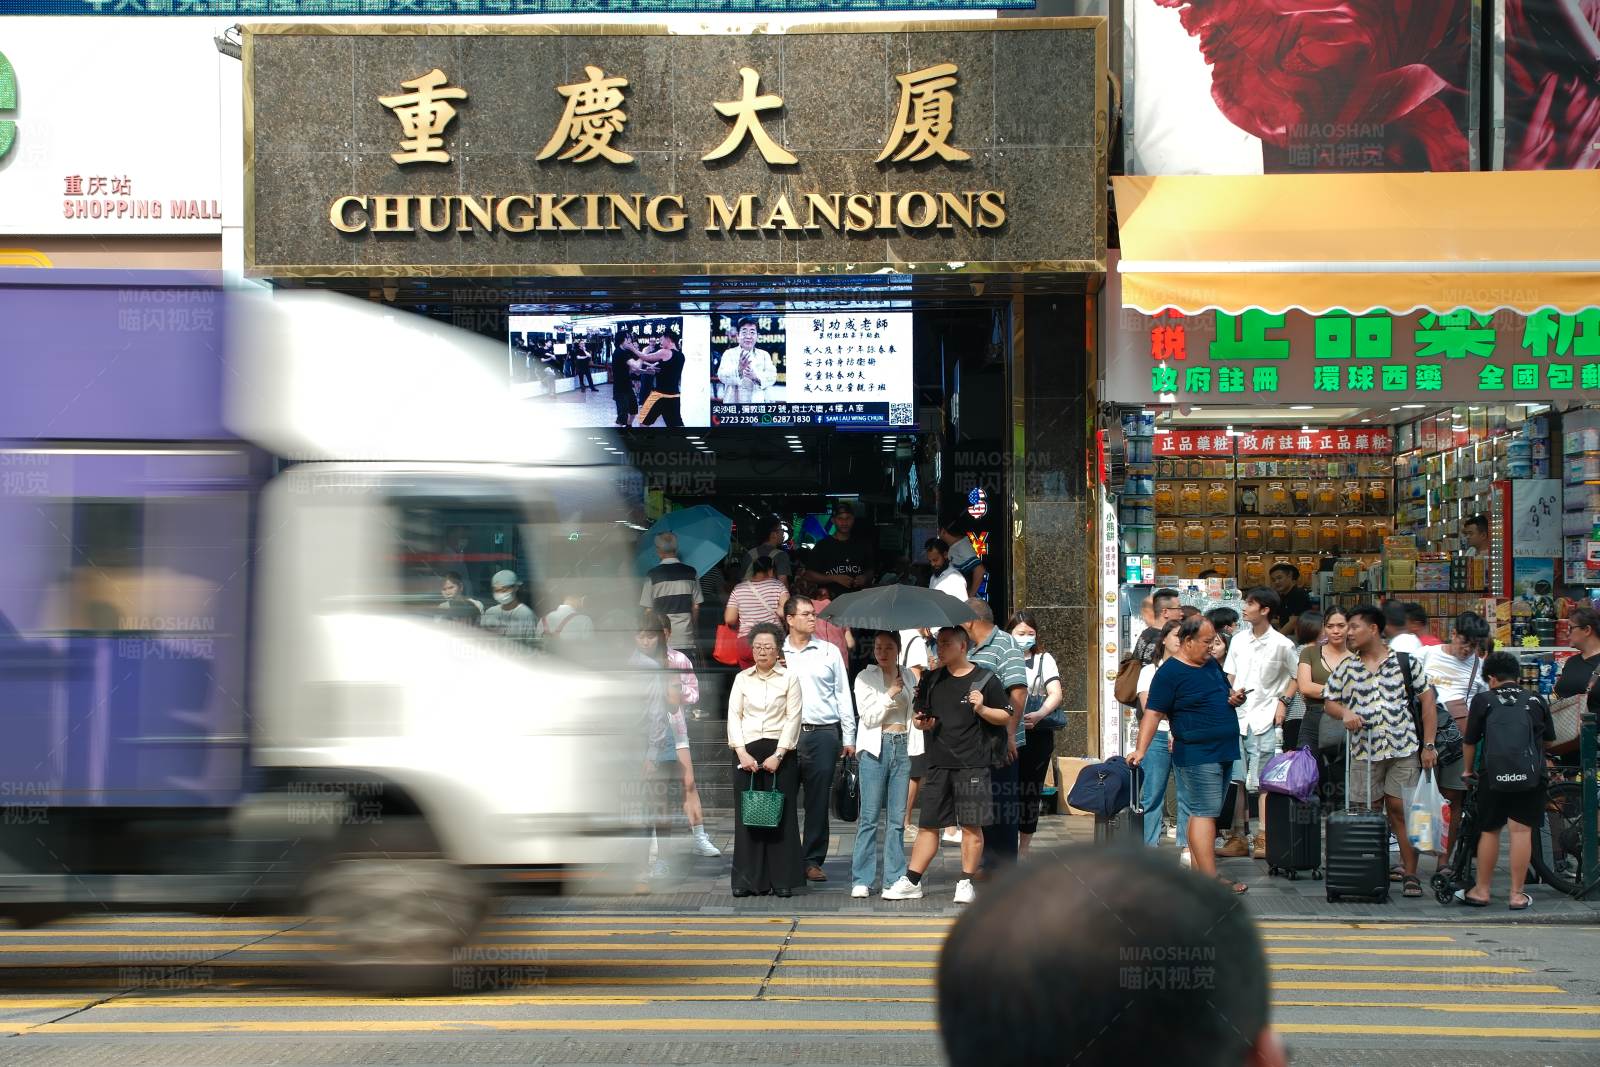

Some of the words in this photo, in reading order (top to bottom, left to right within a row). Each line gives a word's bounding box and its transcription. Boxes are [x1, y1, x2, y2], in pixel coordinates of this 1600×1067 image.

[64, 175, 132, 196] 重庆站
[63, 199, 162, 219] SHOPPING
[170, 199, 222, 219] MALL
[330, 193, 688, 234] CHUNGKING
[705, 191, 1007, 232] MANSIONS
[1151, 366, 1279, 393] 政府註冊
[1313, 364, 1443, 392] 環球西藥
[720, 416, 739, 424] 2723
[740, 416, 759, 424] 2306
[772, 415, 790, 423] 6287
[793, 415, 811, 423] 1830
[1162, 436, 1228, 451] 正品藥粧
[1243, 435, 1312, 450] 政府註冊
[1319, 434, 1387, 449] 正品藥粧
[1496, 773, 1527, 782] adidas
